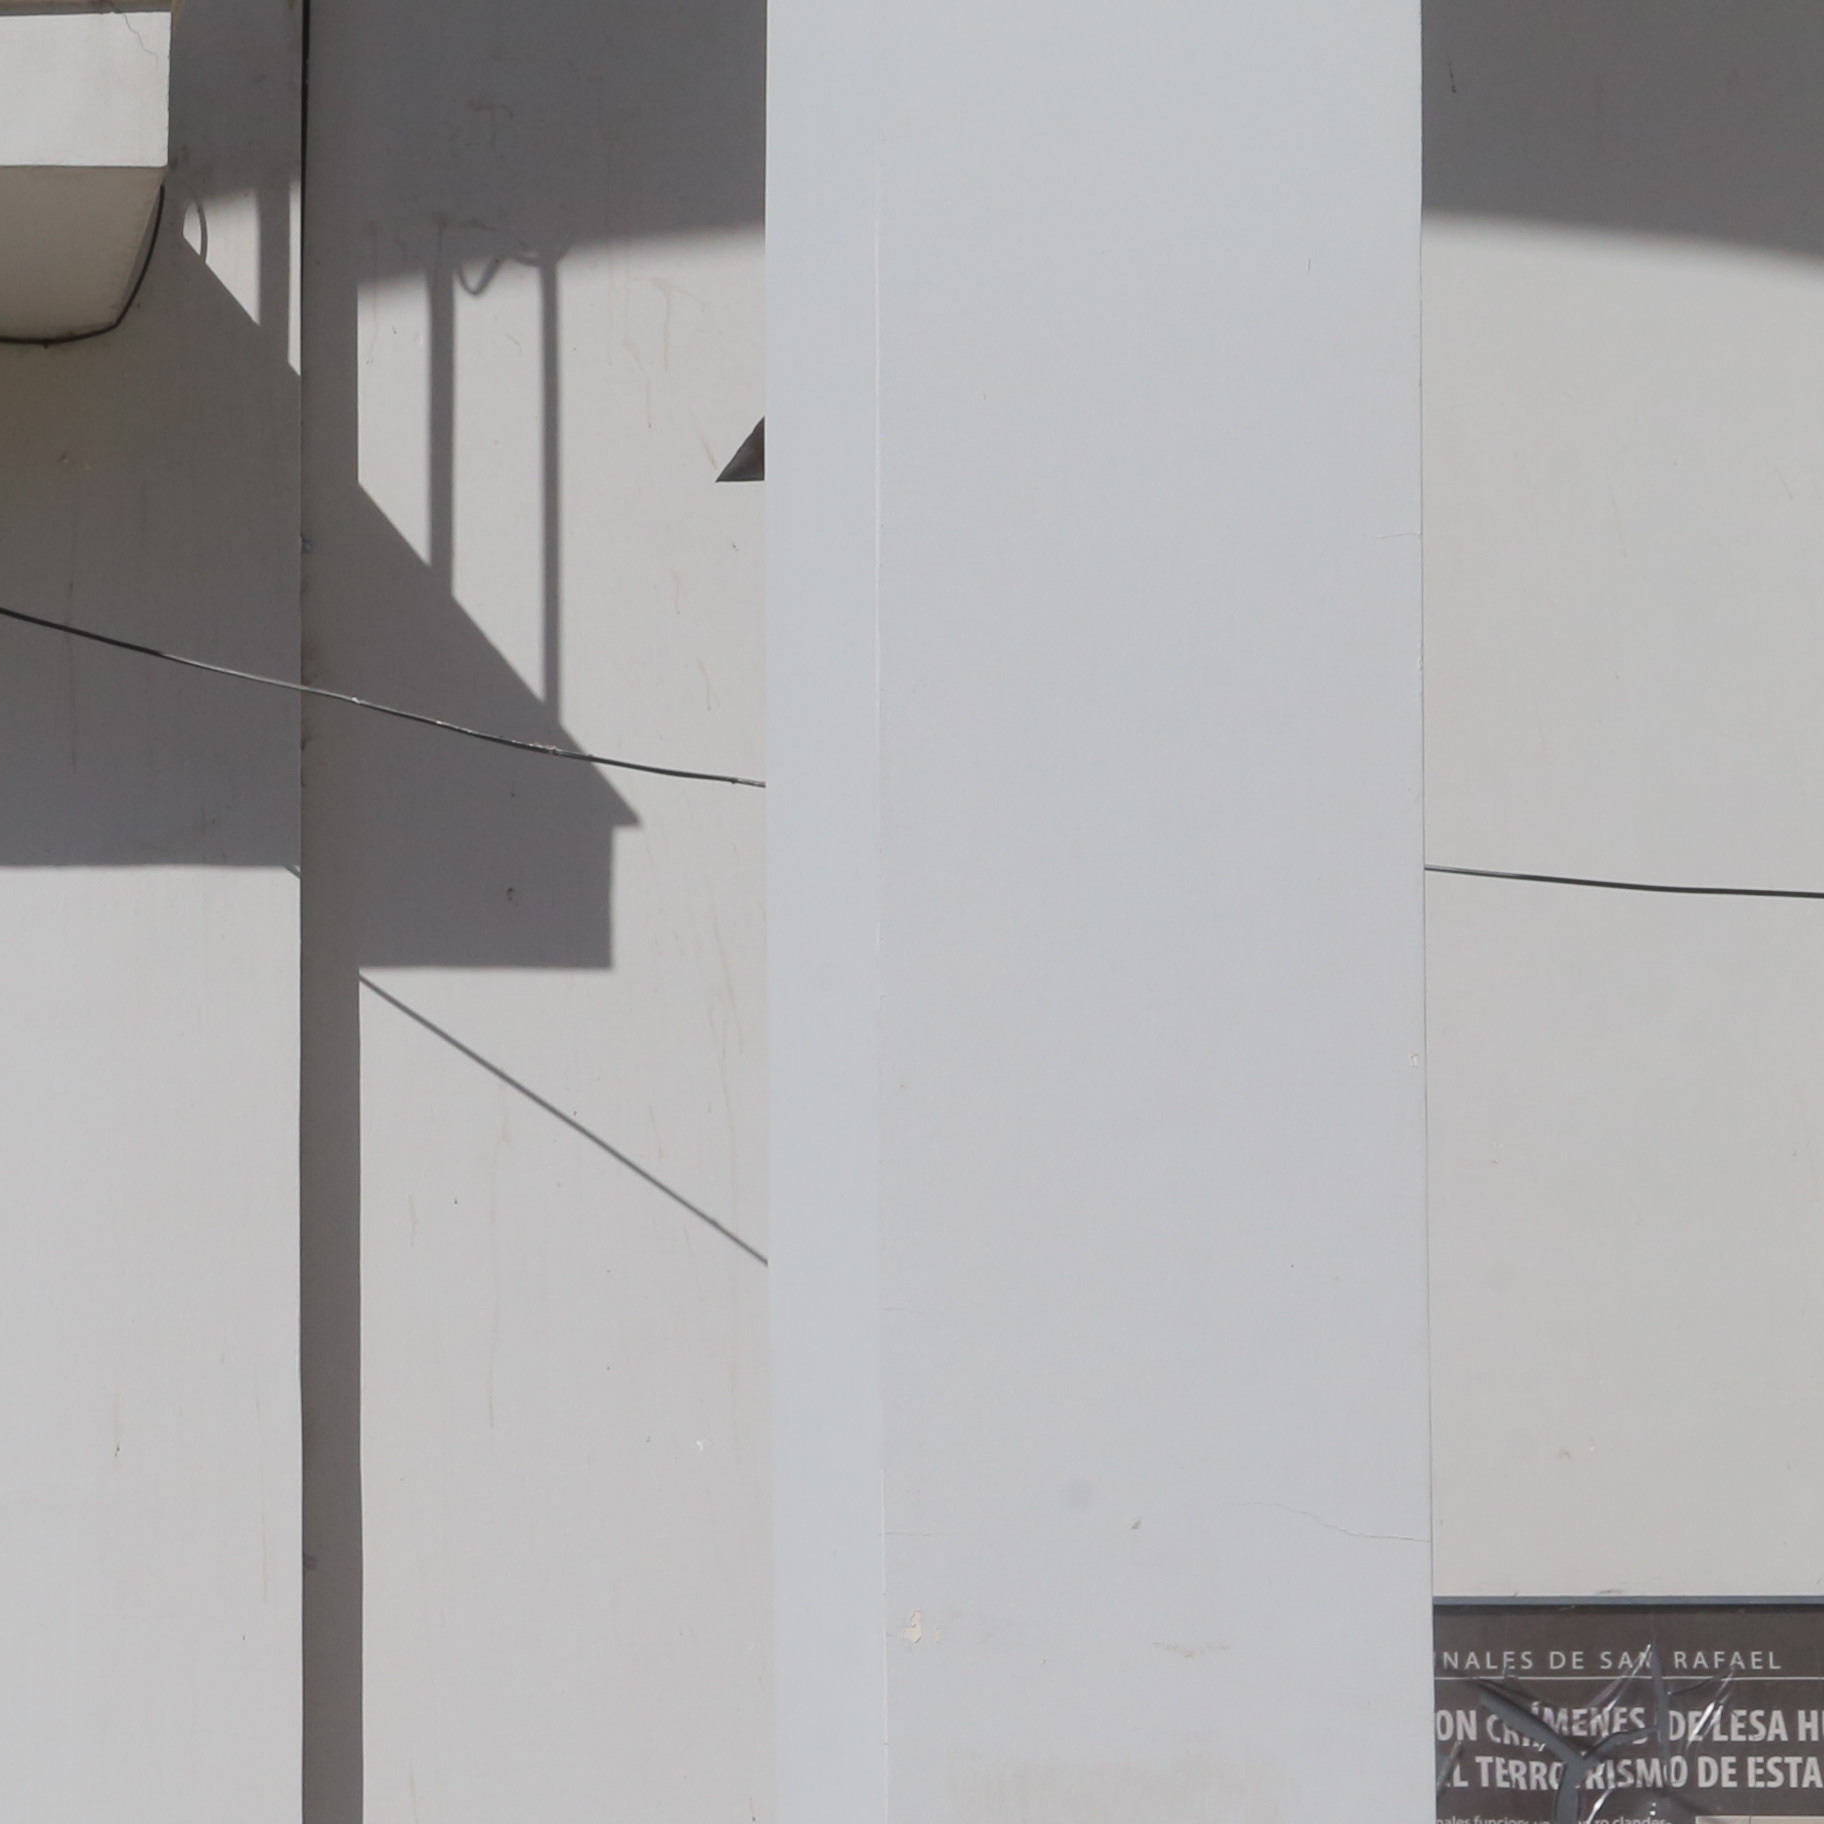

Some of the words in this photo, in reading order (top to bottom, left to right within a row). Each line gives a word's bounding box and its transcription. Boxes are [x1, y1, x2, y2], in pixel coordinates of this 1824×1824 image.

[1549, 1651, 1584, 1670] DE
[1674, 1651, 1782, 1670] RAFAEL
[1712, 1709, 1788, 1742] LESA
[1698, 1756, 1738, 1789] DE
